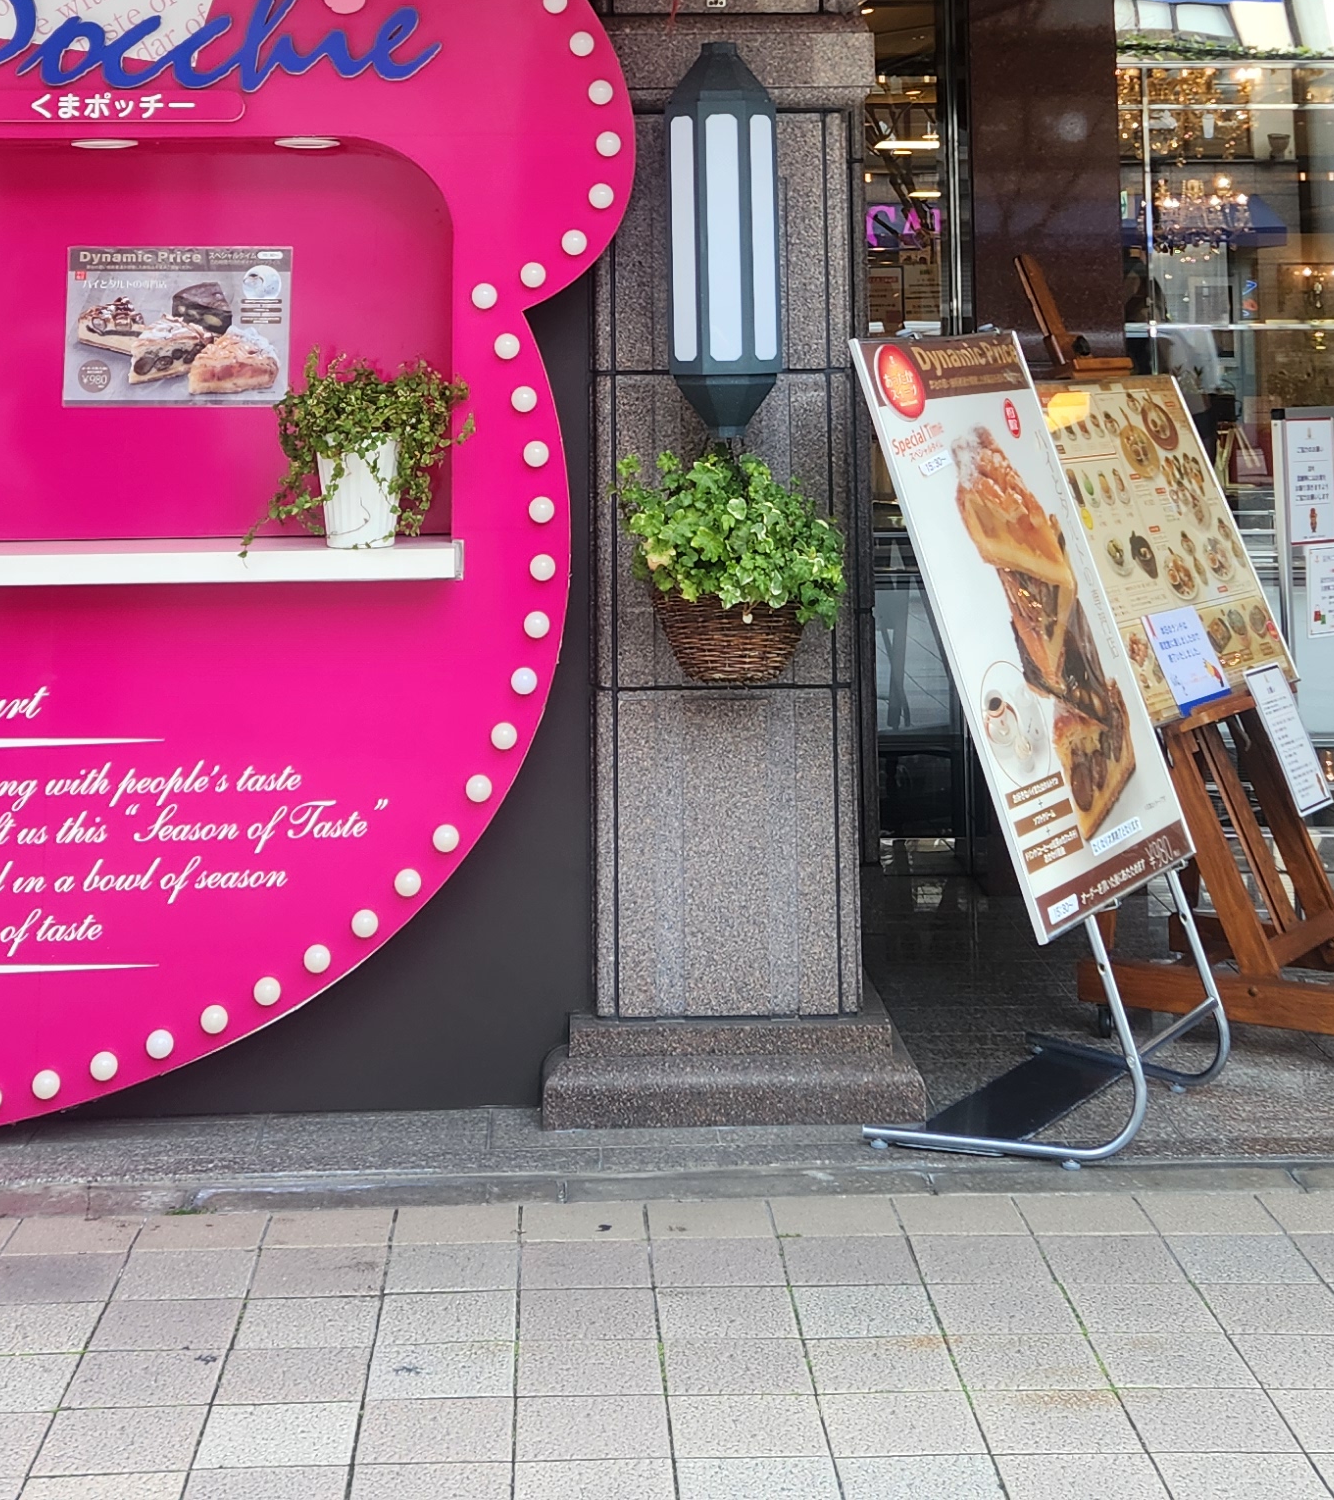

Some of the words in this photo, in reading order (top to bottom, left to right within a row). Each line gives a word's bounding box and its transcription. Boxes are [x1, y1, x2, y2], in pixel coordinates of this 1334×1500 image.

[29, 91, 197, 120] くまポッチー
[79, 251, 154, 265] Dynamic
[157, 250, 203, 263] Price
[910, 342, 986, 376] Dynamic
[979, 340, 1018, 365] Price
[891, 429, 927, 458] Special
[44, 761, 112, 797] with
[236, 764, 303, 793] taste
[17, 823, 49, 846] us
[55, 810, 108, 844] this
[247, 804, 288, 854] of
[12, 870, 47, 894] in
[53, 871, 76, 892] a
[83, 857, 162, 893] bowl
[160, 855, 202, 904] of
[195, 866, 288, 891] season
[0, 908, 43, 957] of
[35, 912, 103, 943] taste
